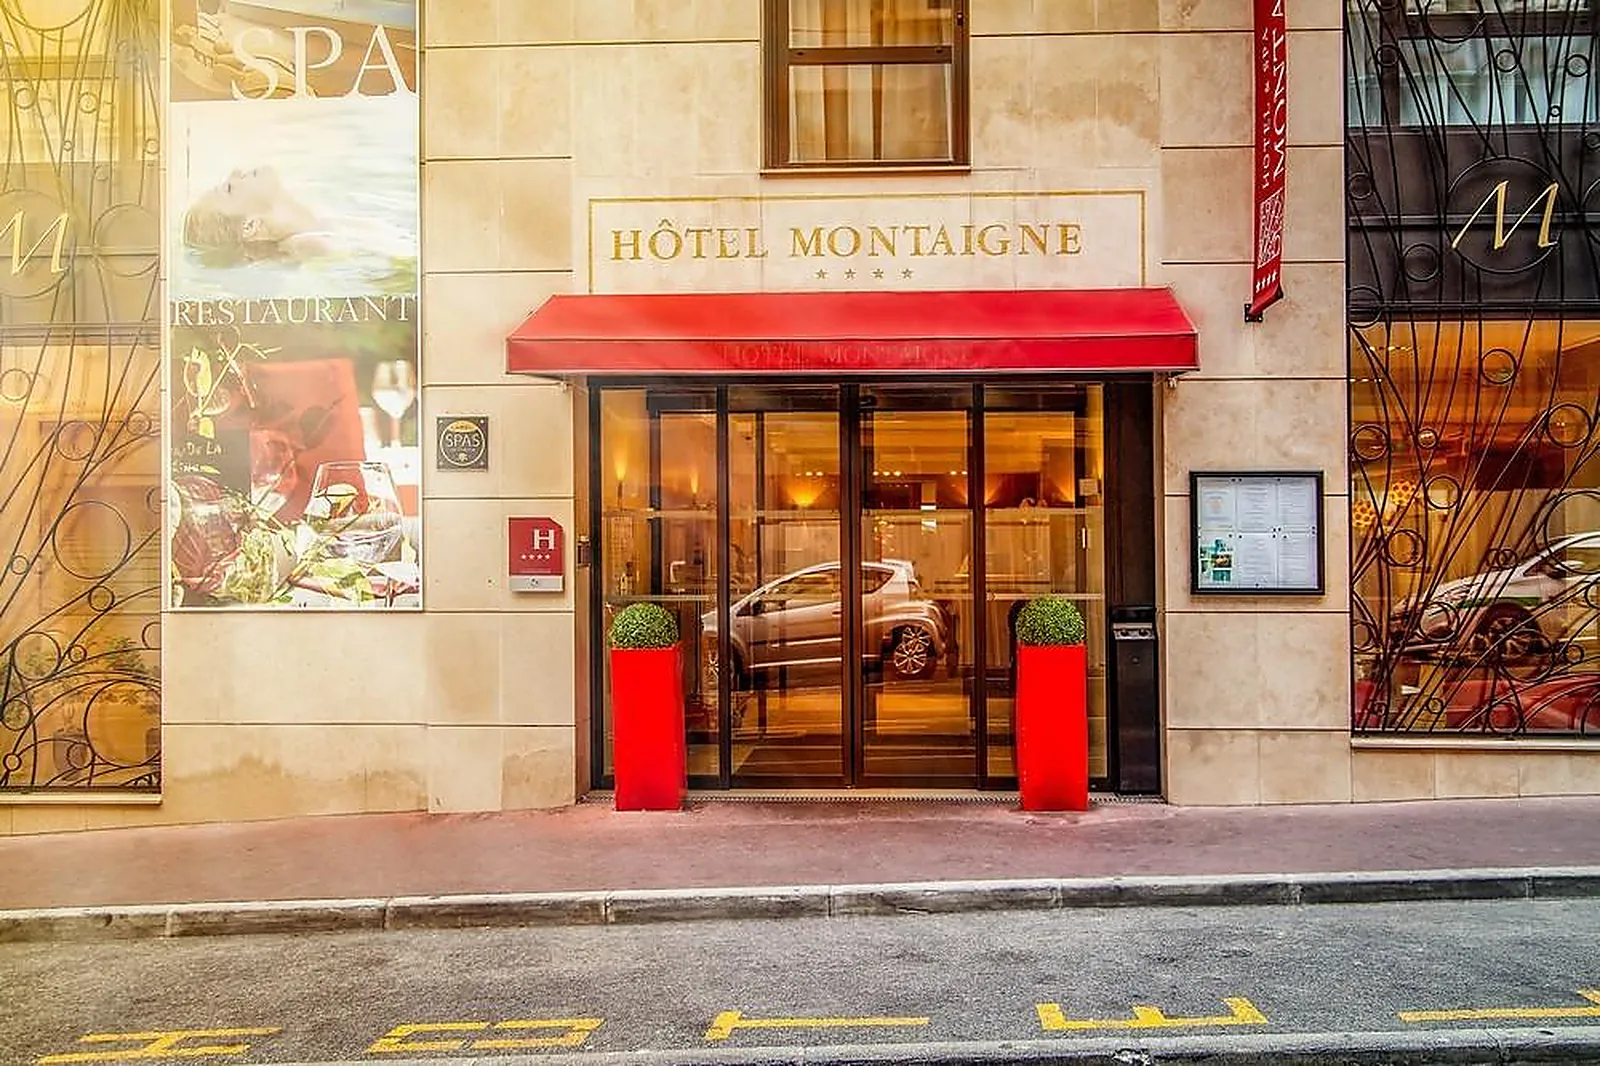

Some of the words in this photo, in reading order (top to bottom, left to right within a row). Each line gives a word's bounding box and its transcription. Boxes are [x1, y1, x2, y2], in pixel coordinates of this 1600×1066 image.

[231, 24, 418, 100] SPA
[610, 218, 769, 261] HÔTEL
[788, 223, 1083, 257] MONTAIGNE
[172, 293, 416, 326] RESTAURANT
[445, 433, 480, 448] SPAS
[533, 529, 555, 550] H
